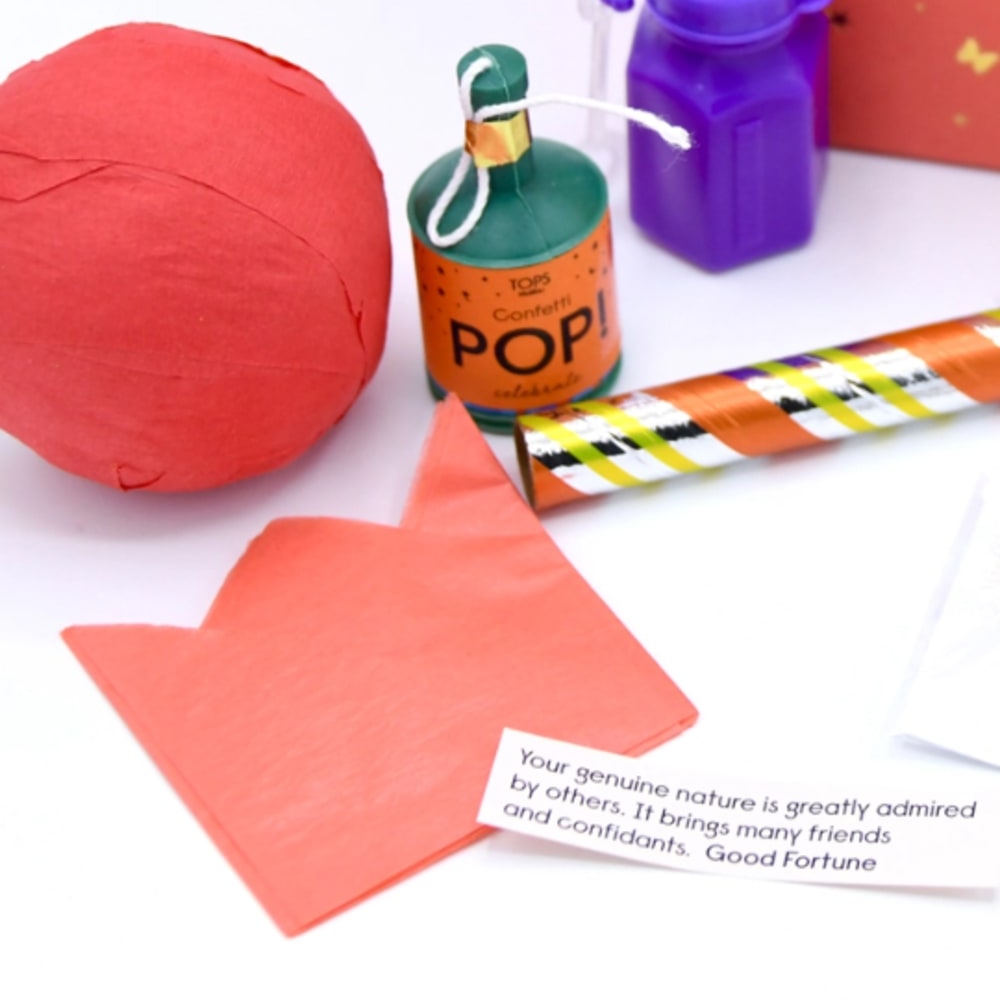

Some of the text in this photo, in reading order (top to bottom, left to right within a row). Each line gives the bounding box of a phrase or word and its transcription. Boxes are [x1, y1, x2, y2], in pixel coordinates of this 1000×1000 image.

[492, 294, 573, 323] Confetti
[508, 271, 552, 292] TOPS
[449, 288, 608, 376] POP!
[509, 772, 892, 847] by others. It brings many friends
[518, 746, 978, 821] Your genuine nature is greatly admired
[502, 801, 878, 873] and confidants. Good Fortune
